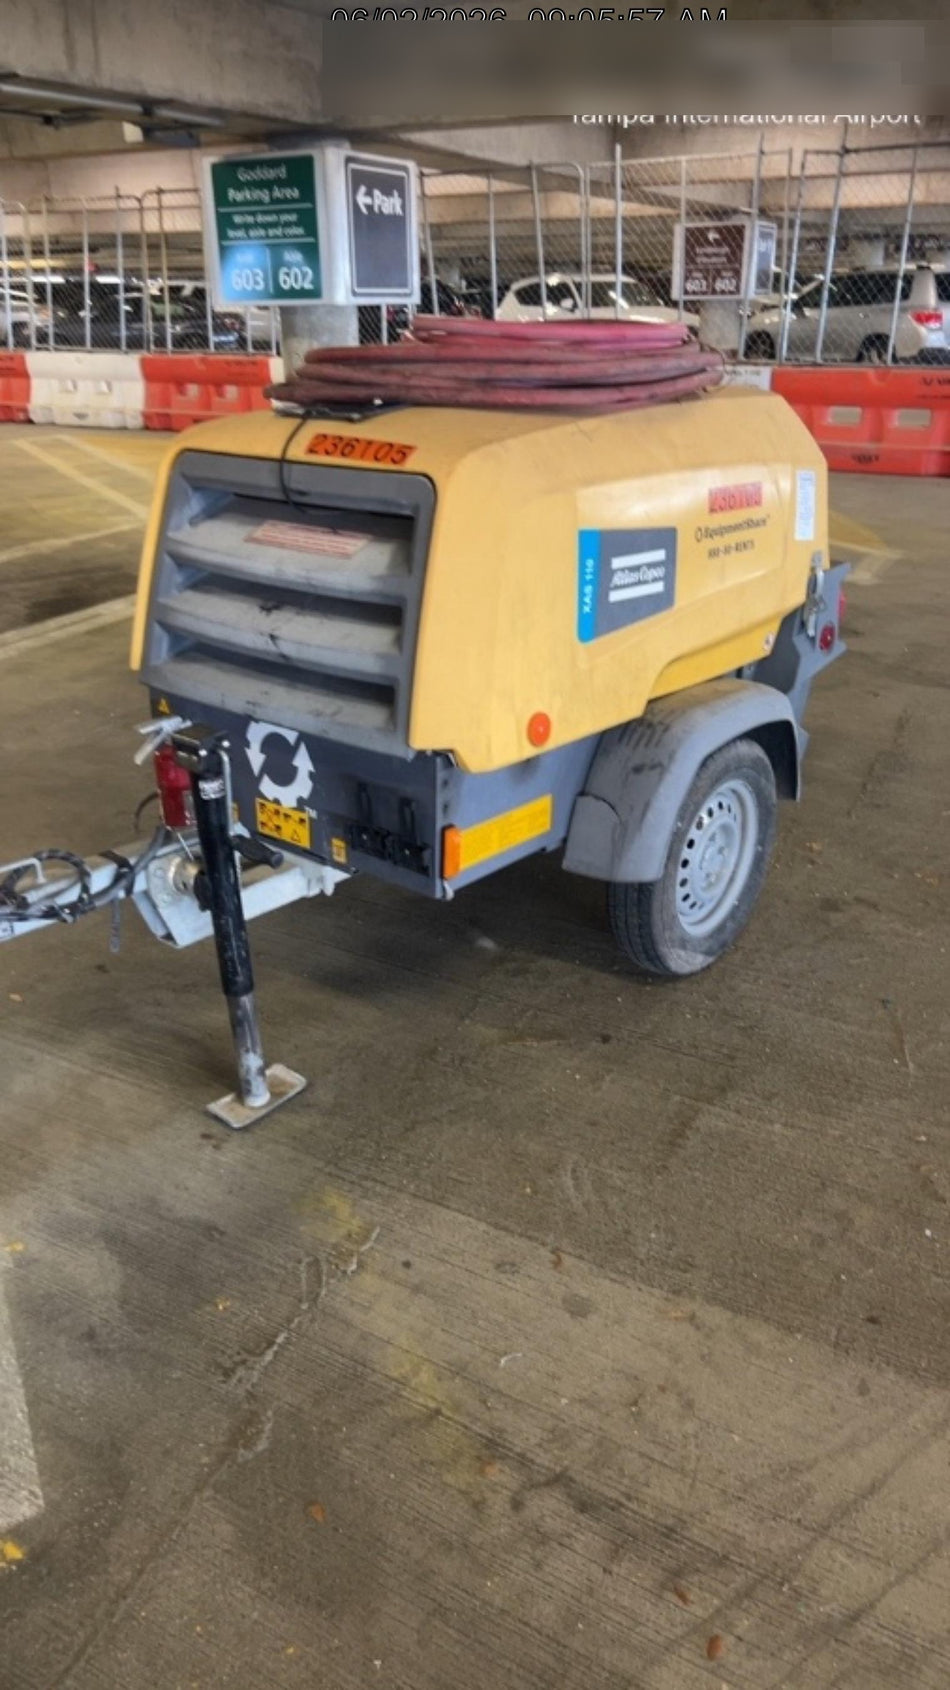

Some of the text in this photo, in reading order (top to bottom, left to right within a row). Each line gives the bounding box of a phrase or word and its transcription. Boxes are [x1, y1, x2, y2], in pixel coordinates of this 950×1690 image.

[227, 185, 300, 204] Parking Area
[372, 188, 404, 216] Park
[232, 266, 314, 291] 603 602
[307, 433, 416, 465] 236105
[610, 564, 665, 588] Atlas Copco
[582, 584, 594, 615] XAS
